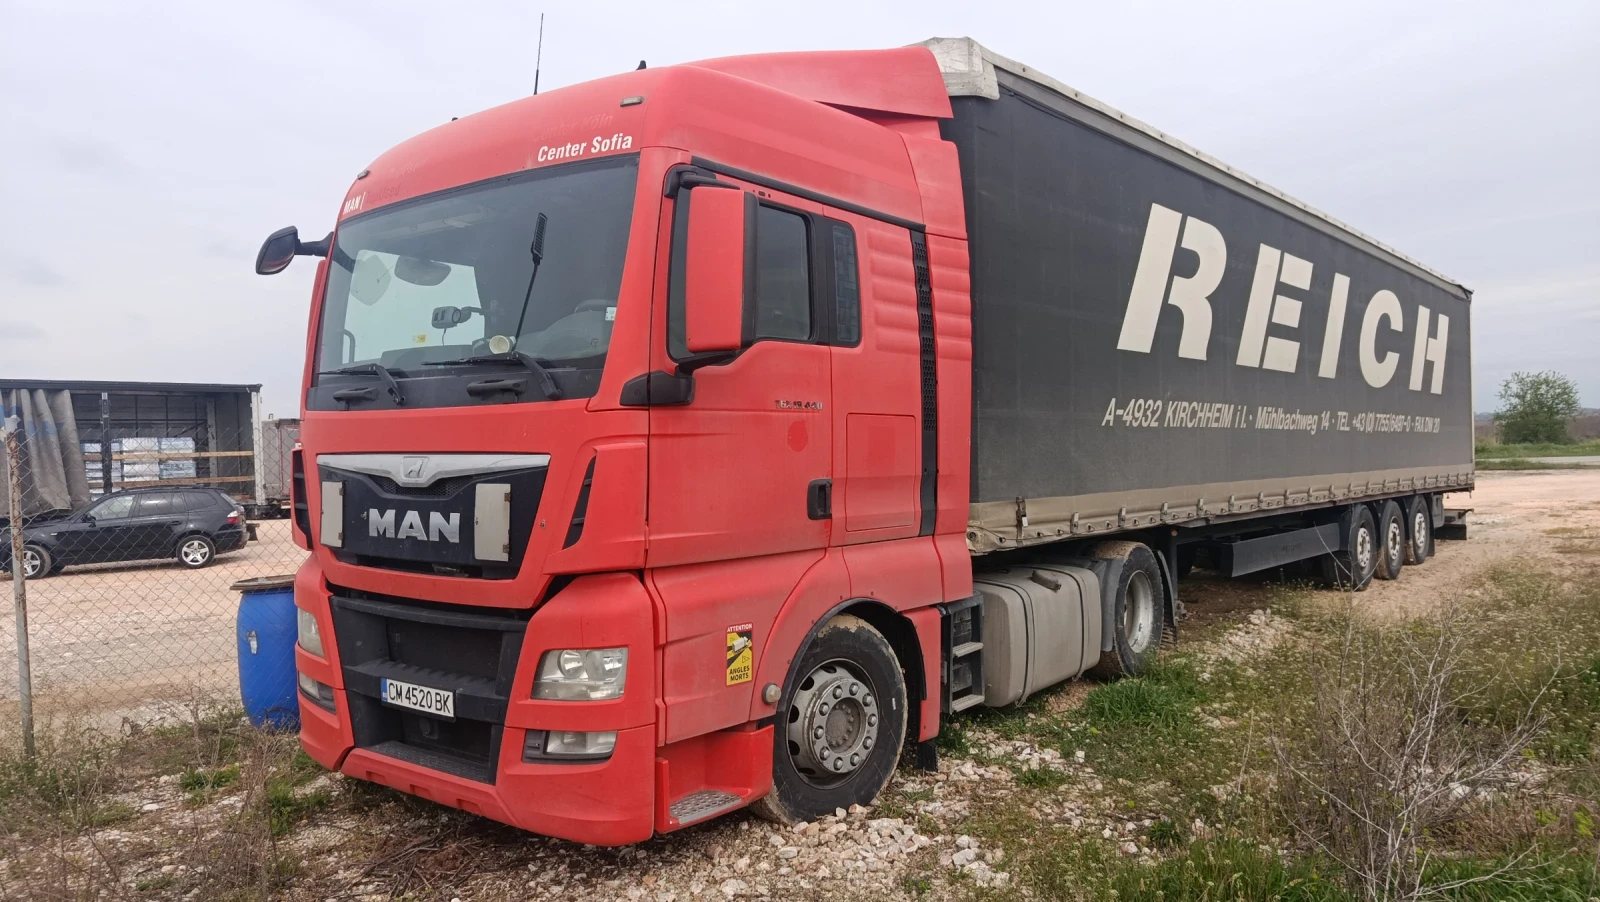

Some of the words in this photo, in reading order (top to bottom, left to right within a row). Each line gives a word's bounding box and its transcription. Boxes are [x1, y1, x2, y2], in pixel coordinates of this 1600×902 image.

[537, 142, 587, 162] Center
[591, 133, 633, 154] Sofia
[343, 195, 362, 215] MAN
[1116, 202, 1450, 395] REICH
[1102, 397, 1163, 428] A-4932
[1164, 400, 1235, 428] KIRCHHEIM
[1255, 405, 1318, 435] Mühlbachweg
[1320, 410, 1331, 431] 14
[1352, 412, 1366, 432] +43
[1365, 411, 1375, 433] (0)
[1414, 416, 1425, 433] FAX
[368, 508, 461, 544] MAN
[727, 623, 753, 633] ATTENTION
[729, 665, 750, 675] ANGLES
[730, 672, 749, 681] MORTS
[388, 682, 403, 703] CM
[404, 686, 433, 709] 4520
[434, 692, 451, 714] BK
